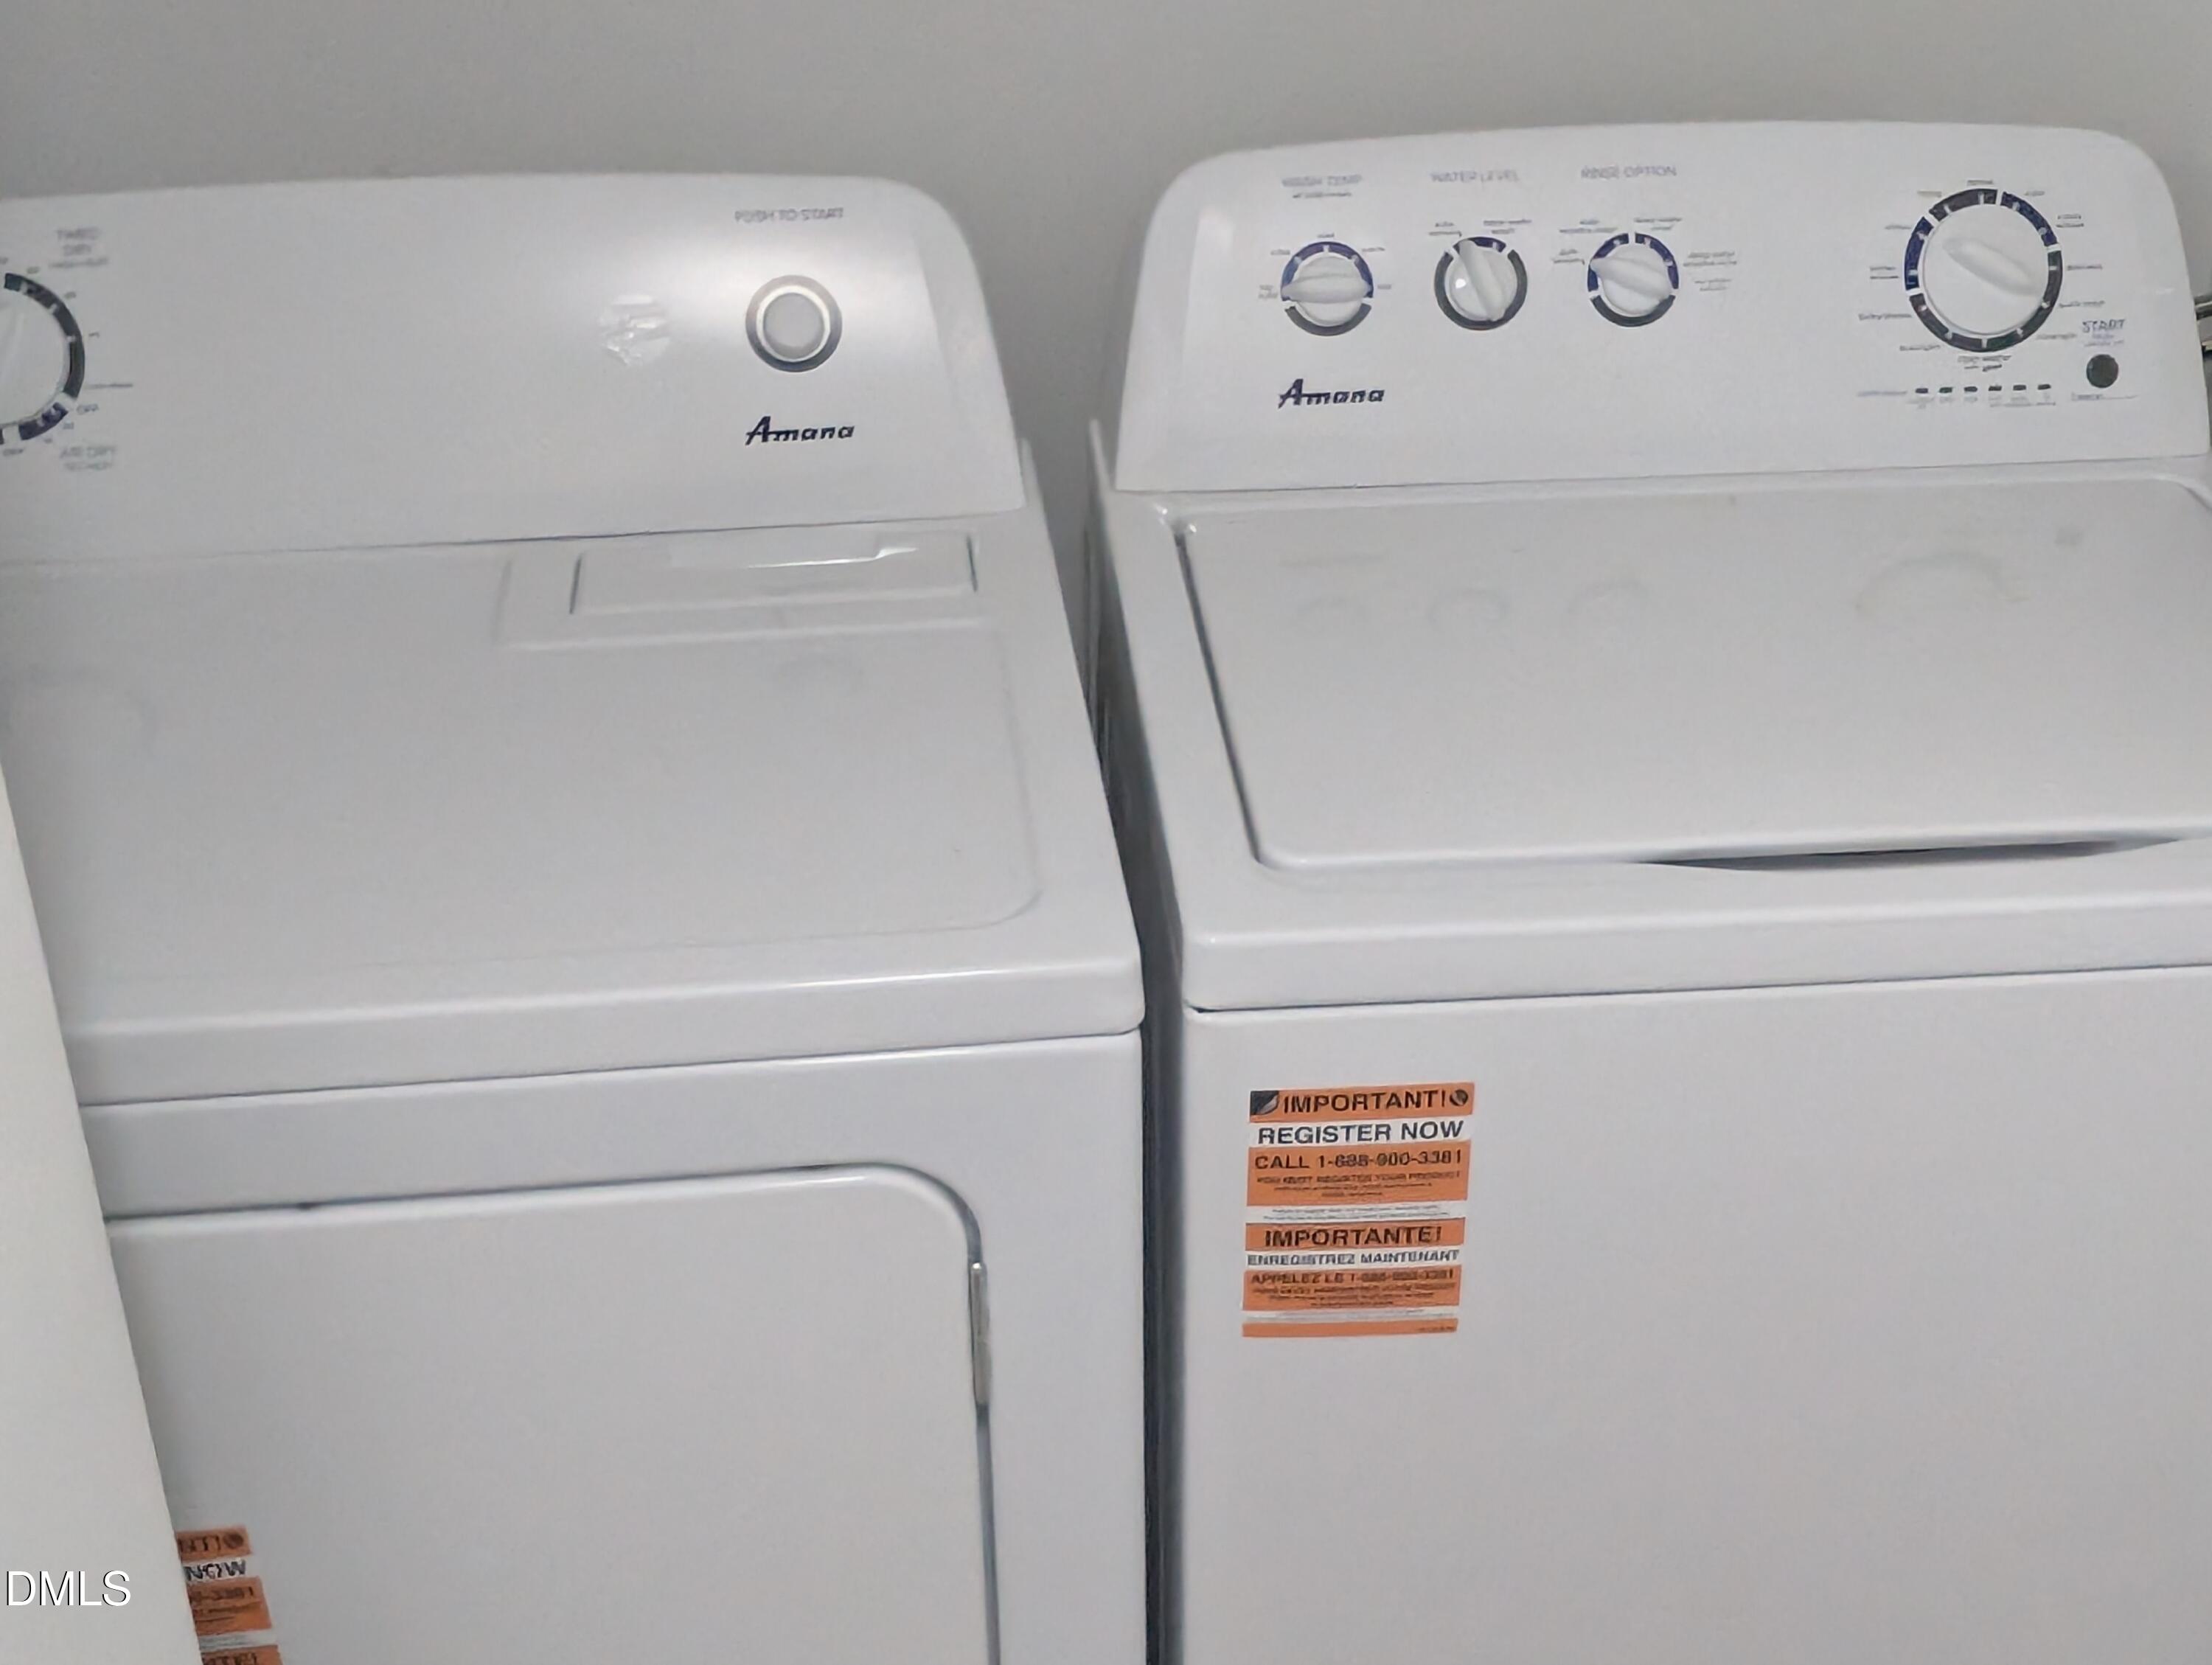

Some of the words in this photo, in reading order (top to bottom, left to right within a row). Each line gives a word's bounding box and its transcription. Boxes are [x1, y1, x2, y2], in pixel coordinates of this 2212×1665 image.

[1279, 378, 1385, 409] Amana
[745, 416, 855, 445] Amana
[1284, 1089, 1447, 1113] IMPORTANT!
[1258, 1123, 1392, 1144] REGISTER
[1400, 1120, 1464, 1140] NOW
[1254, 1155, 1310, 1169] CALL
[1265, 1226, 1442, 1247] IMPORTANTE!
[184, 1558, 247, 1581] NOW
